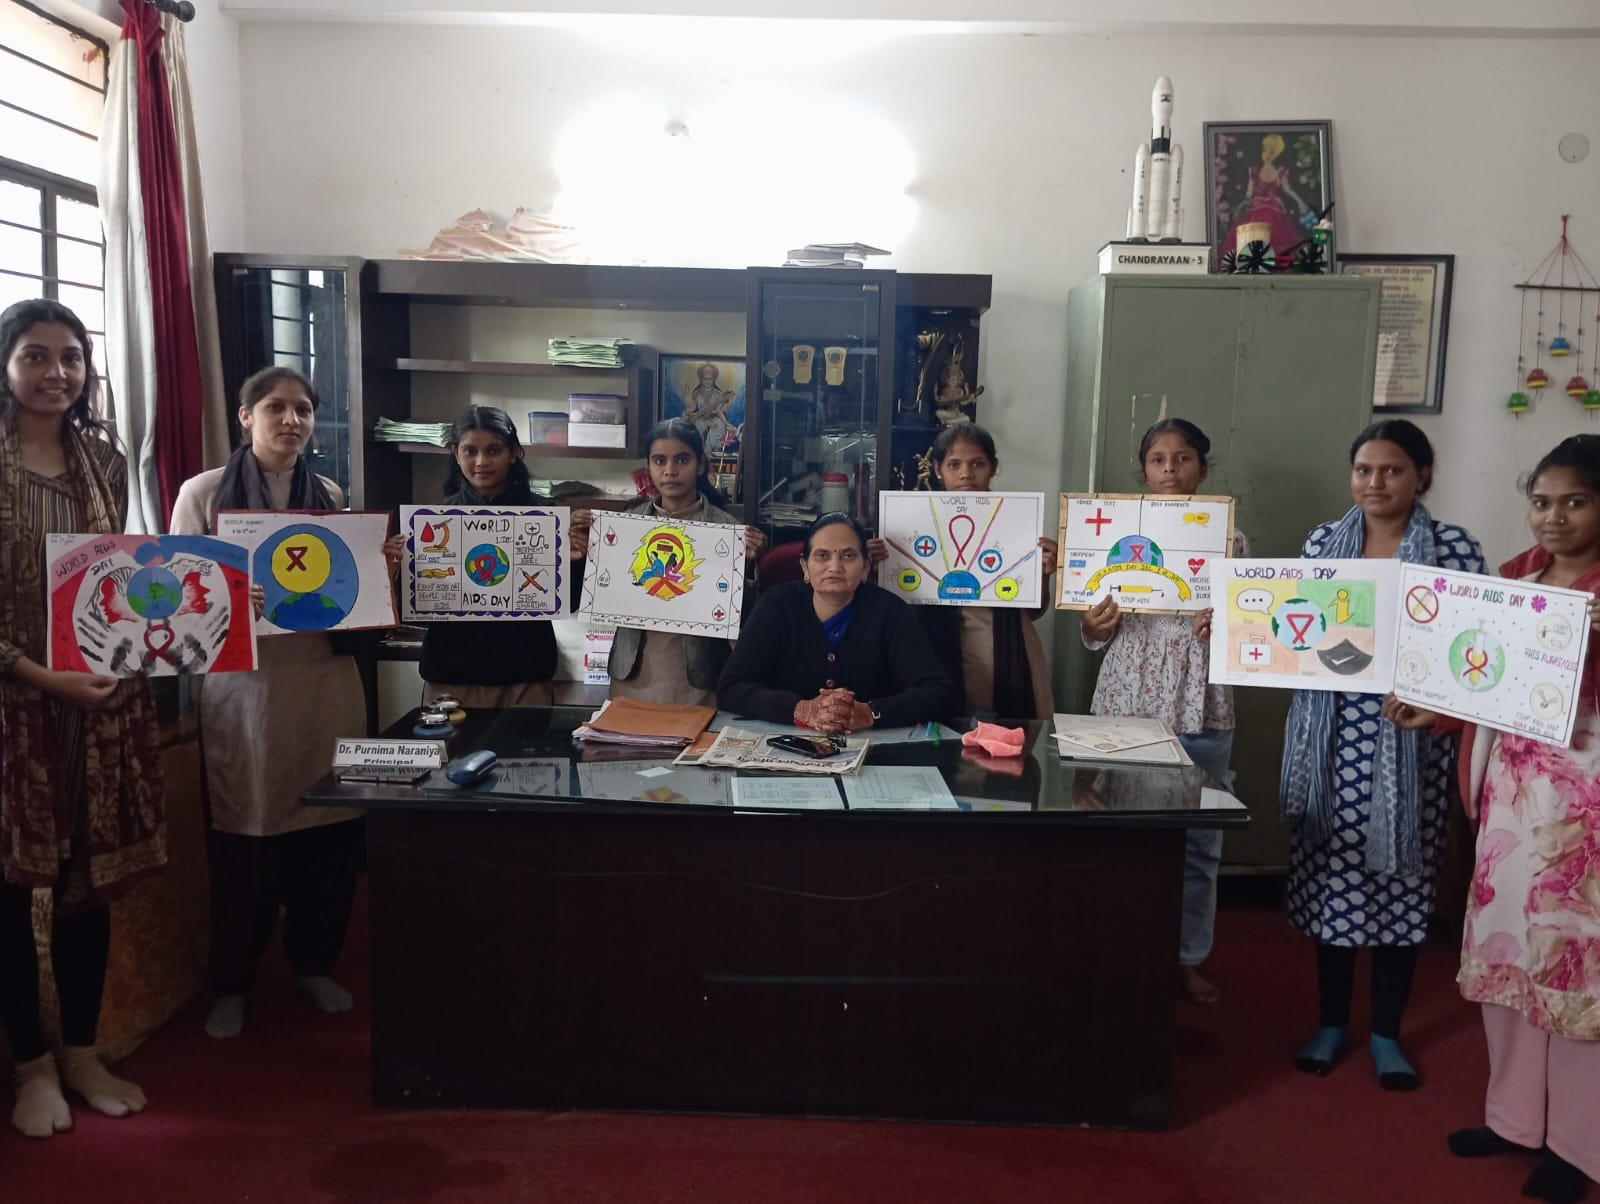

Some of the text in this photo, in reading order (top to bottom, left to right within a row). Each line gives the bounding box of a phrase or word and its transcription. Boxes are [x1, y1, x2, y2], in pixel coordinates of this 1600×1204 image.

[1118, 255, 1190, 265] CHANDRAYAAN
[941, 497, 967, 505] WORLD
[464, 519, 510, 533] WORLD
[56, 553, 89, 577] WORLD
[90, 558, 114, 576] DAY
[1234, 567, 1337, 580] WORLD AIDS DAY
[463, 592, 511, 609] AIDS DAY
[1450, 584, 1526, 608] WORLD AIDS DAY
[338, 744, 440, 758] Dr. Purnima Naraniya
[363, 758, 414, 766] Principal
